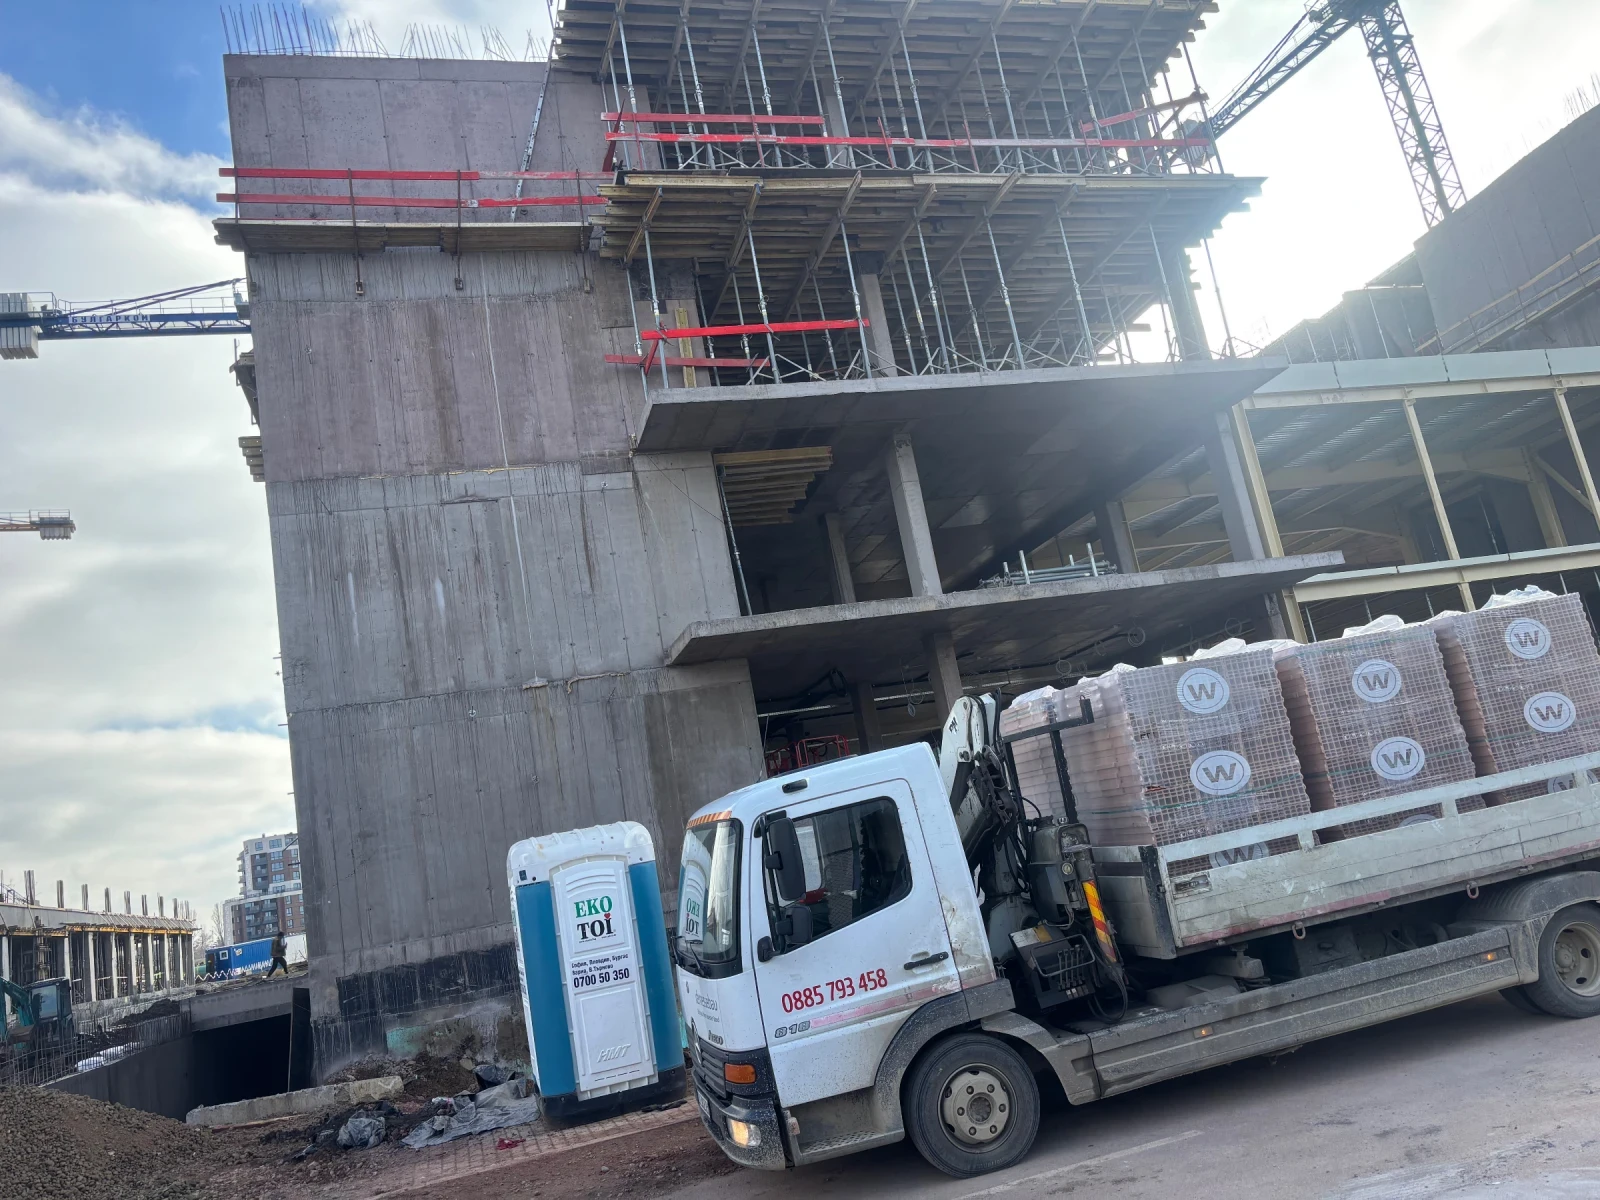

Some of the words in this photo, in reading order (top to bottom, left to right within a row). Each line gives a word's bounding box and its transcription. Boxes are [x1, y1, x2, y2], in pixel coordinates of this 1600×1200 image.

[72, 315, 149, 323] БУЛГАРКОМ
[1514, 630, 1540, 648] W
[1187, 681, 1217, 701] W
[1362, 671, 1389, 692] W
[1534, 703, 1563, 722] W
[1381, 748, 1412, 769] W
[1202, 762, 1237, 783] W
[574, 896, 612, 918] EKO
[573, 974, 597, 988] 0700
[599, 971, 610, 983] 50
[613, 967, 630, 981] 350
[781, 984, 825, 1014] 0885
[826, 977, 856, 1001] 793
[859, 968, 888, 992] 458
